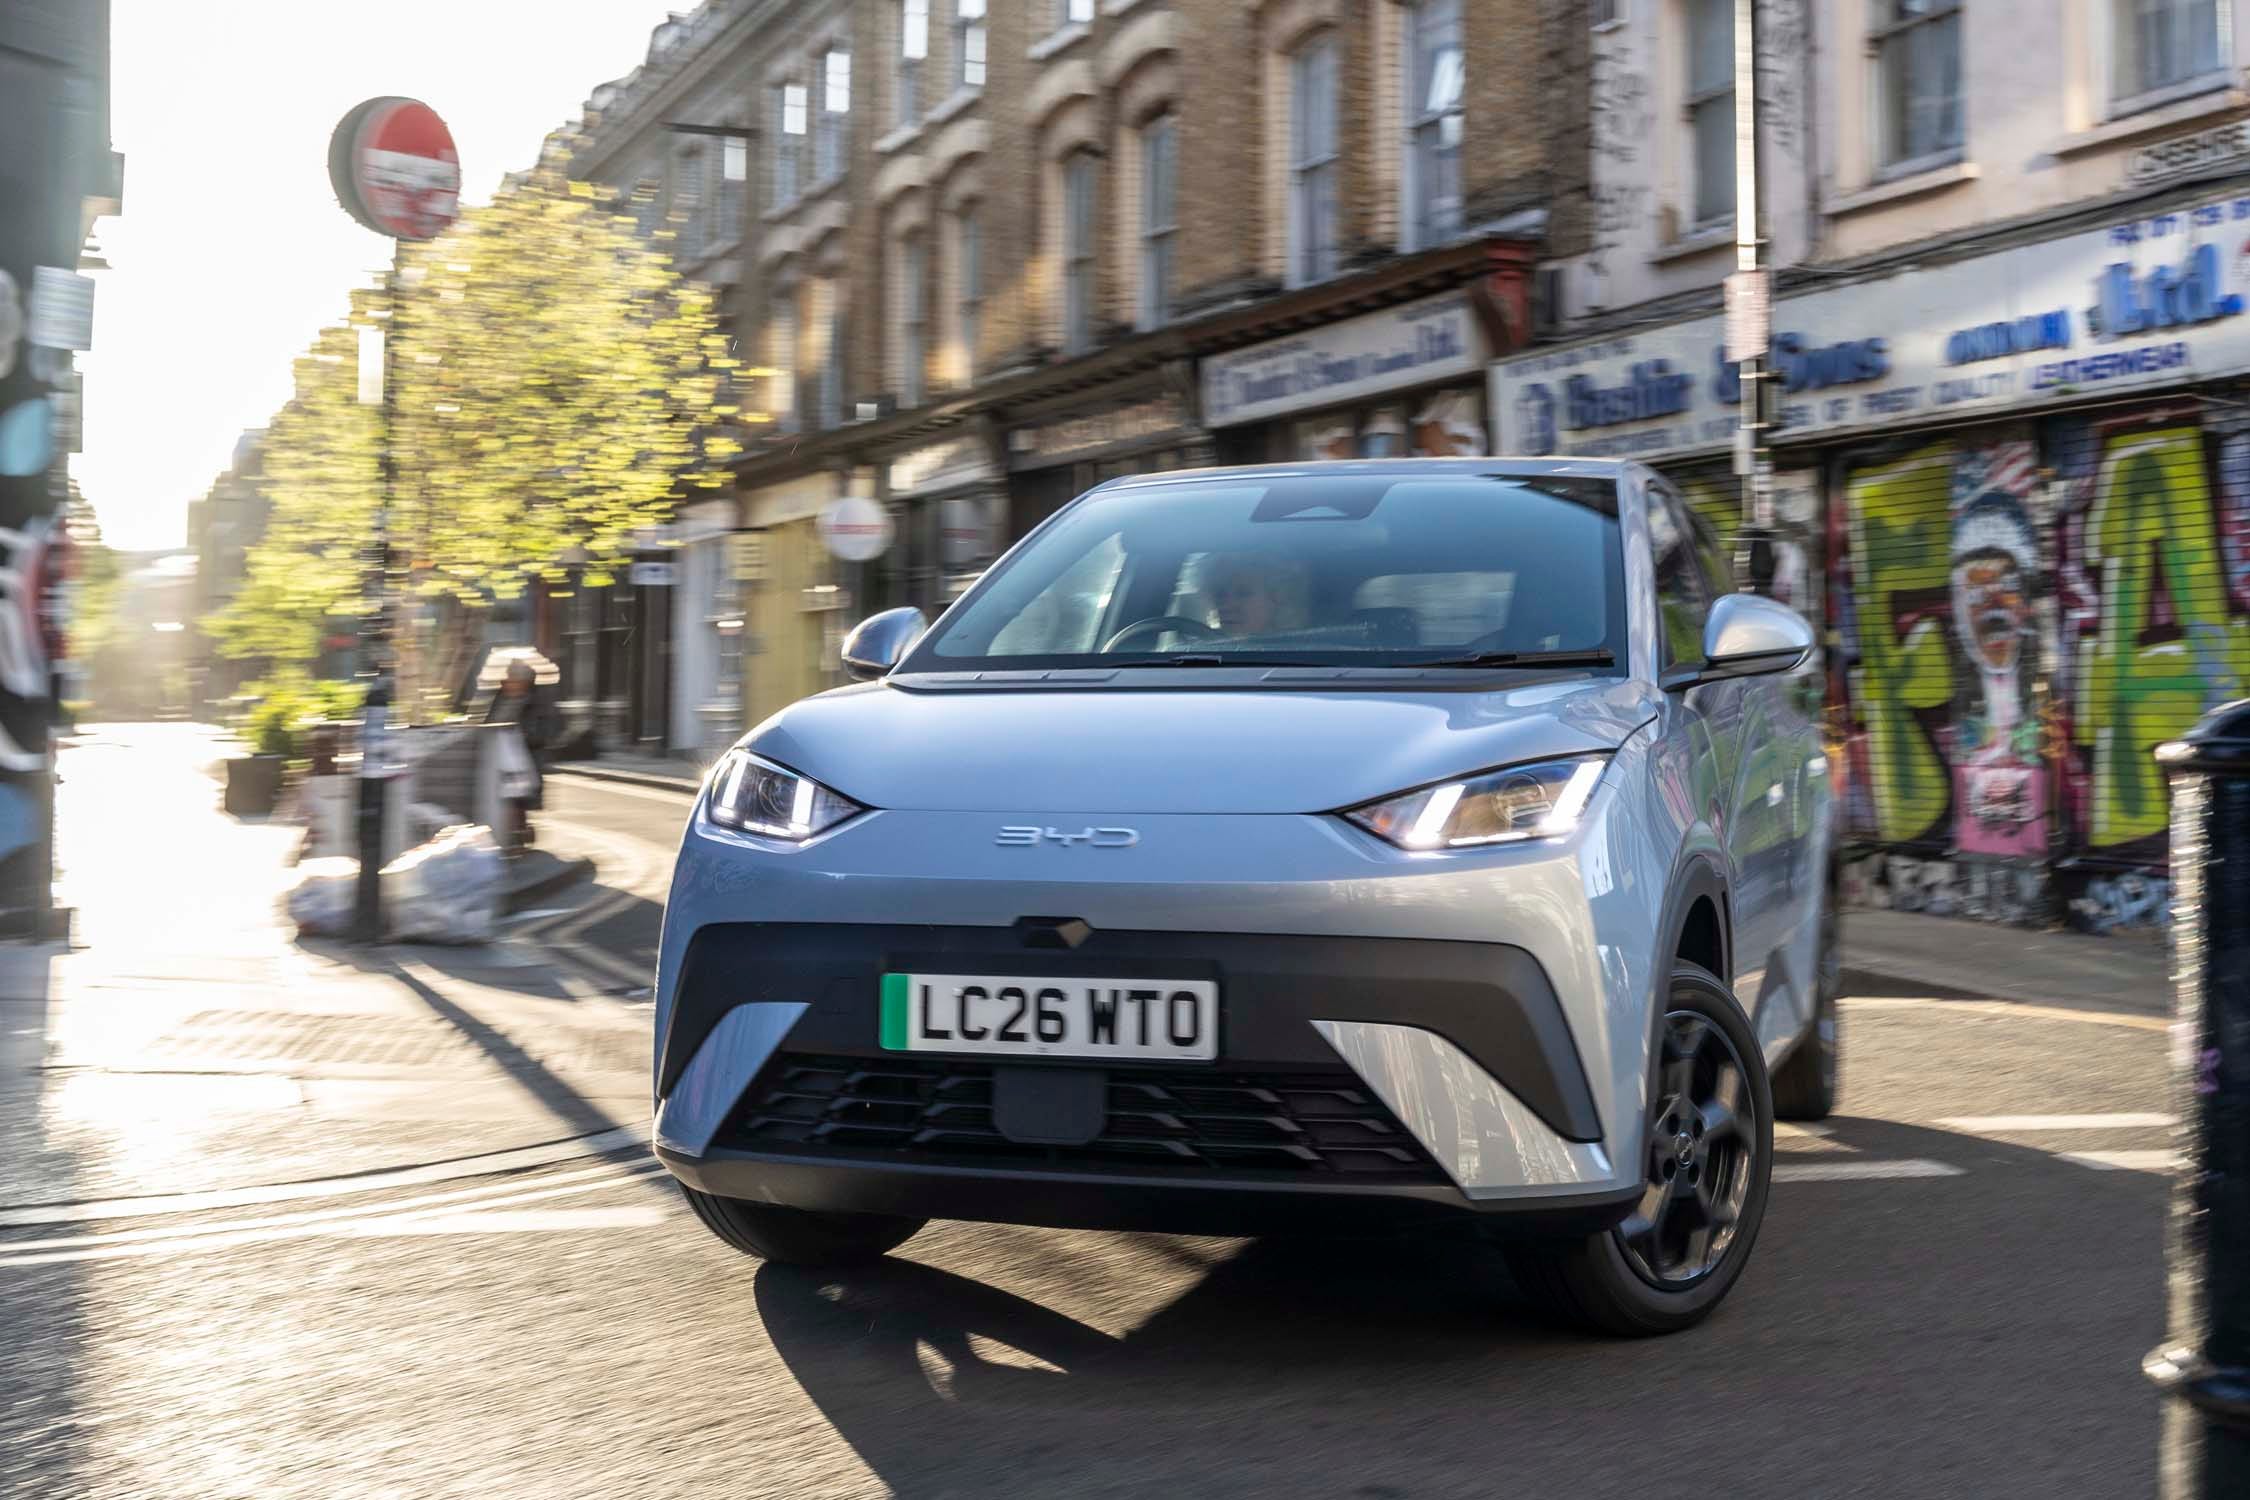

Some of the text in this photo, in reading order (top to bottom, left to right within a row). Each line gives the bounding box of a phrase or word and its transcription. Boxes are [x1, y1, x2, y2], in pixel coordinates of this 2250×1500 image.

[2031, 341, 2191, 390] LEATHERWEAR
[994, 825, 1140, 848] BYD
[918, 983, 1204, 1048] LC26 WTO
